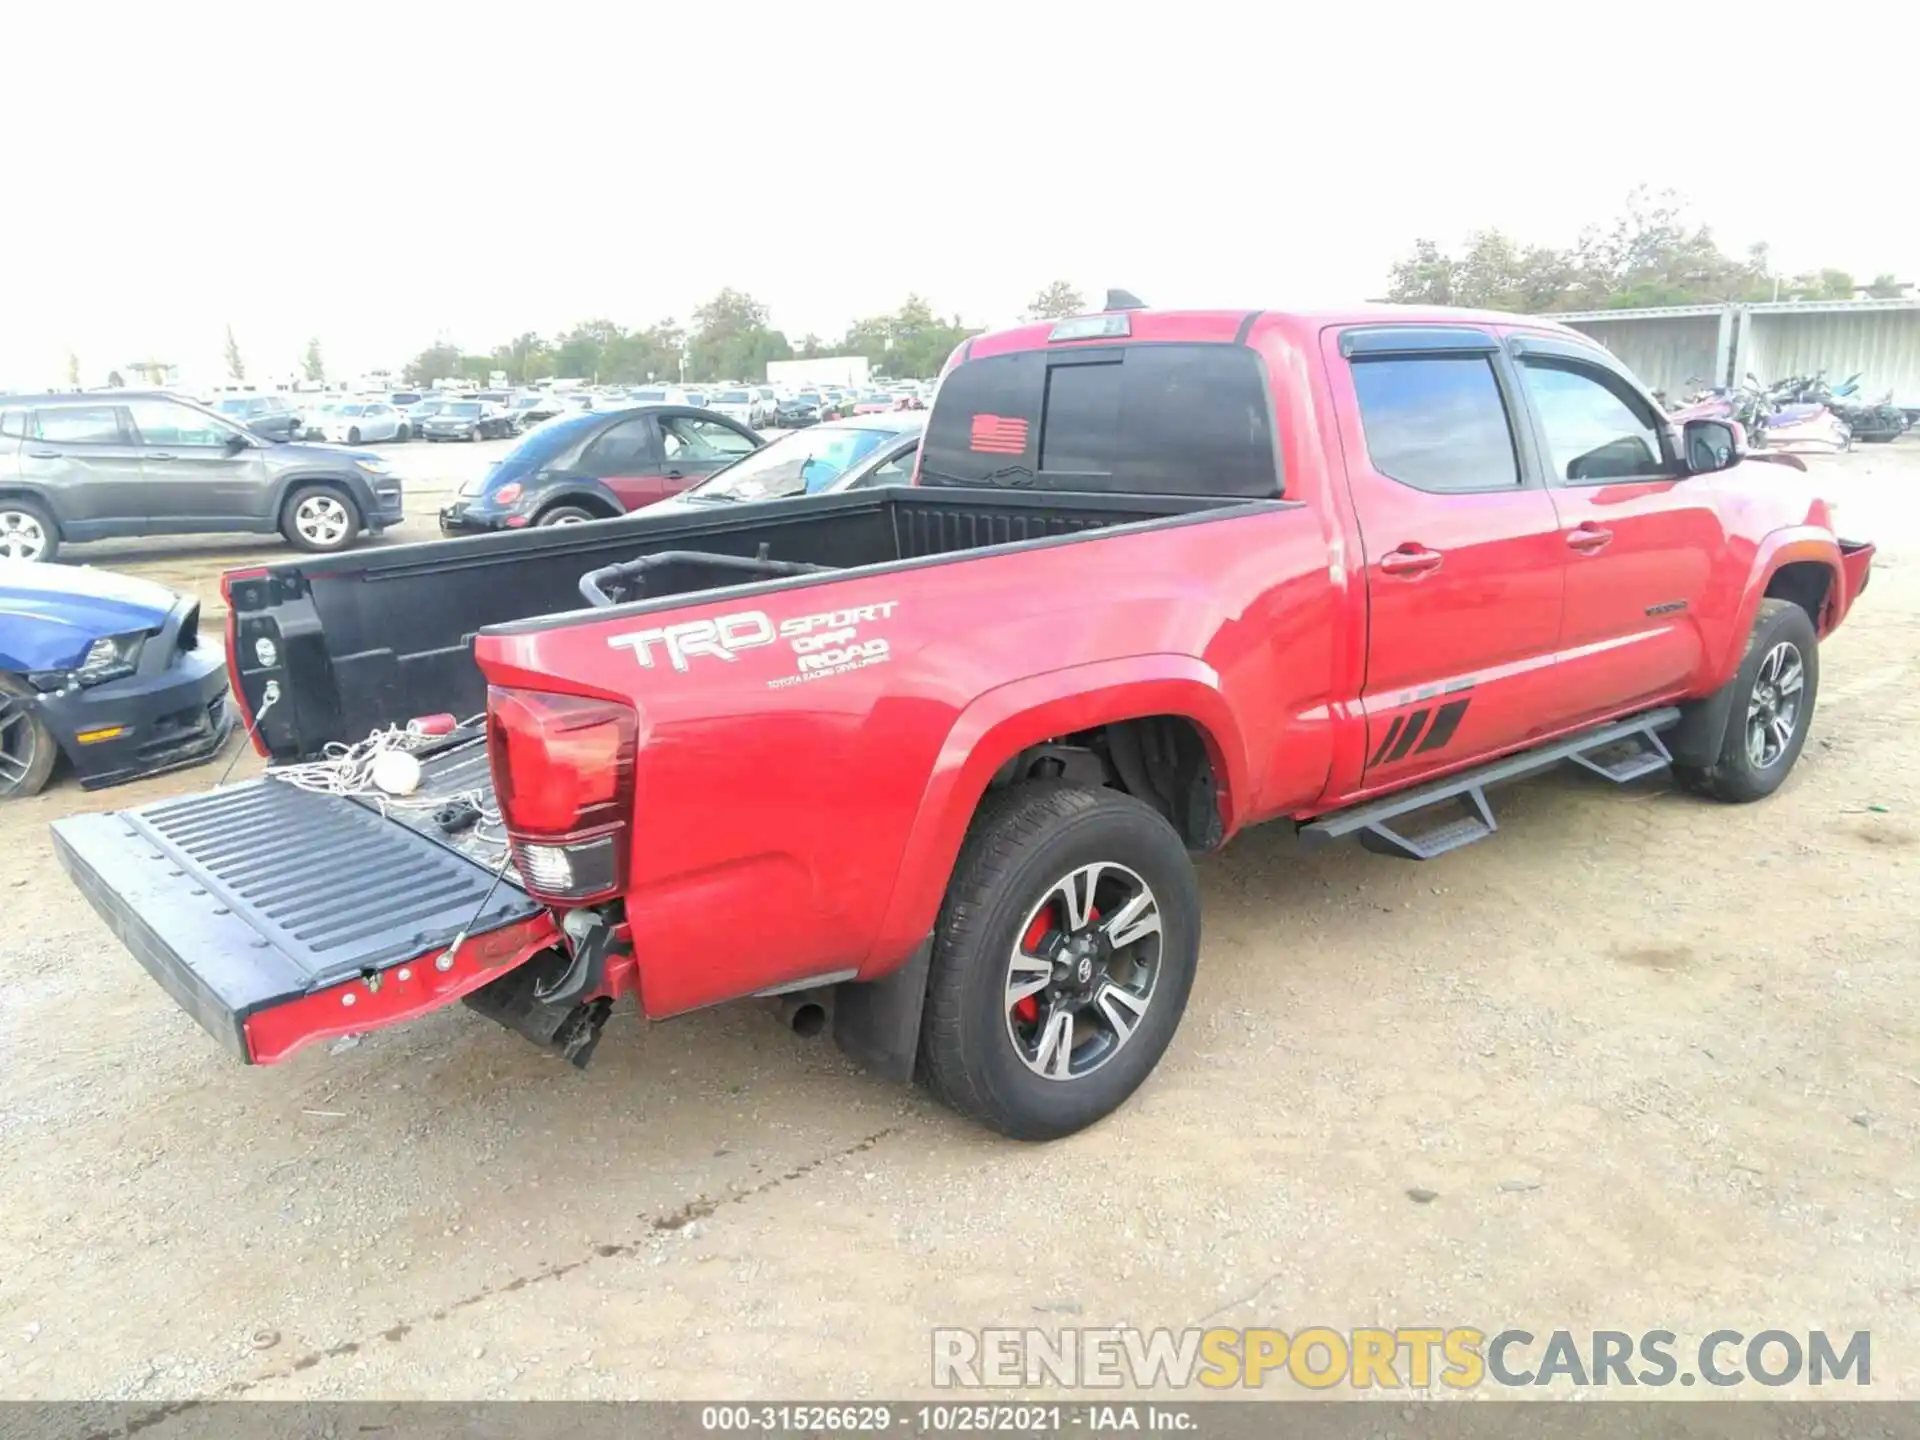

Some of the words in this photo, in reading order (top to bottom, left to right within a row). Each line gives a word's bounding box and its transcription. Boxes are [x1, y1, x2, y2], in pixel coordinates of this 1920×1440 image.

[607, 610, 776, 673] TRD
[779, 601, 899, 637] SPORT
[791, 627, 857, 654] OFF
[797, 638, 890, 672] ROAD
